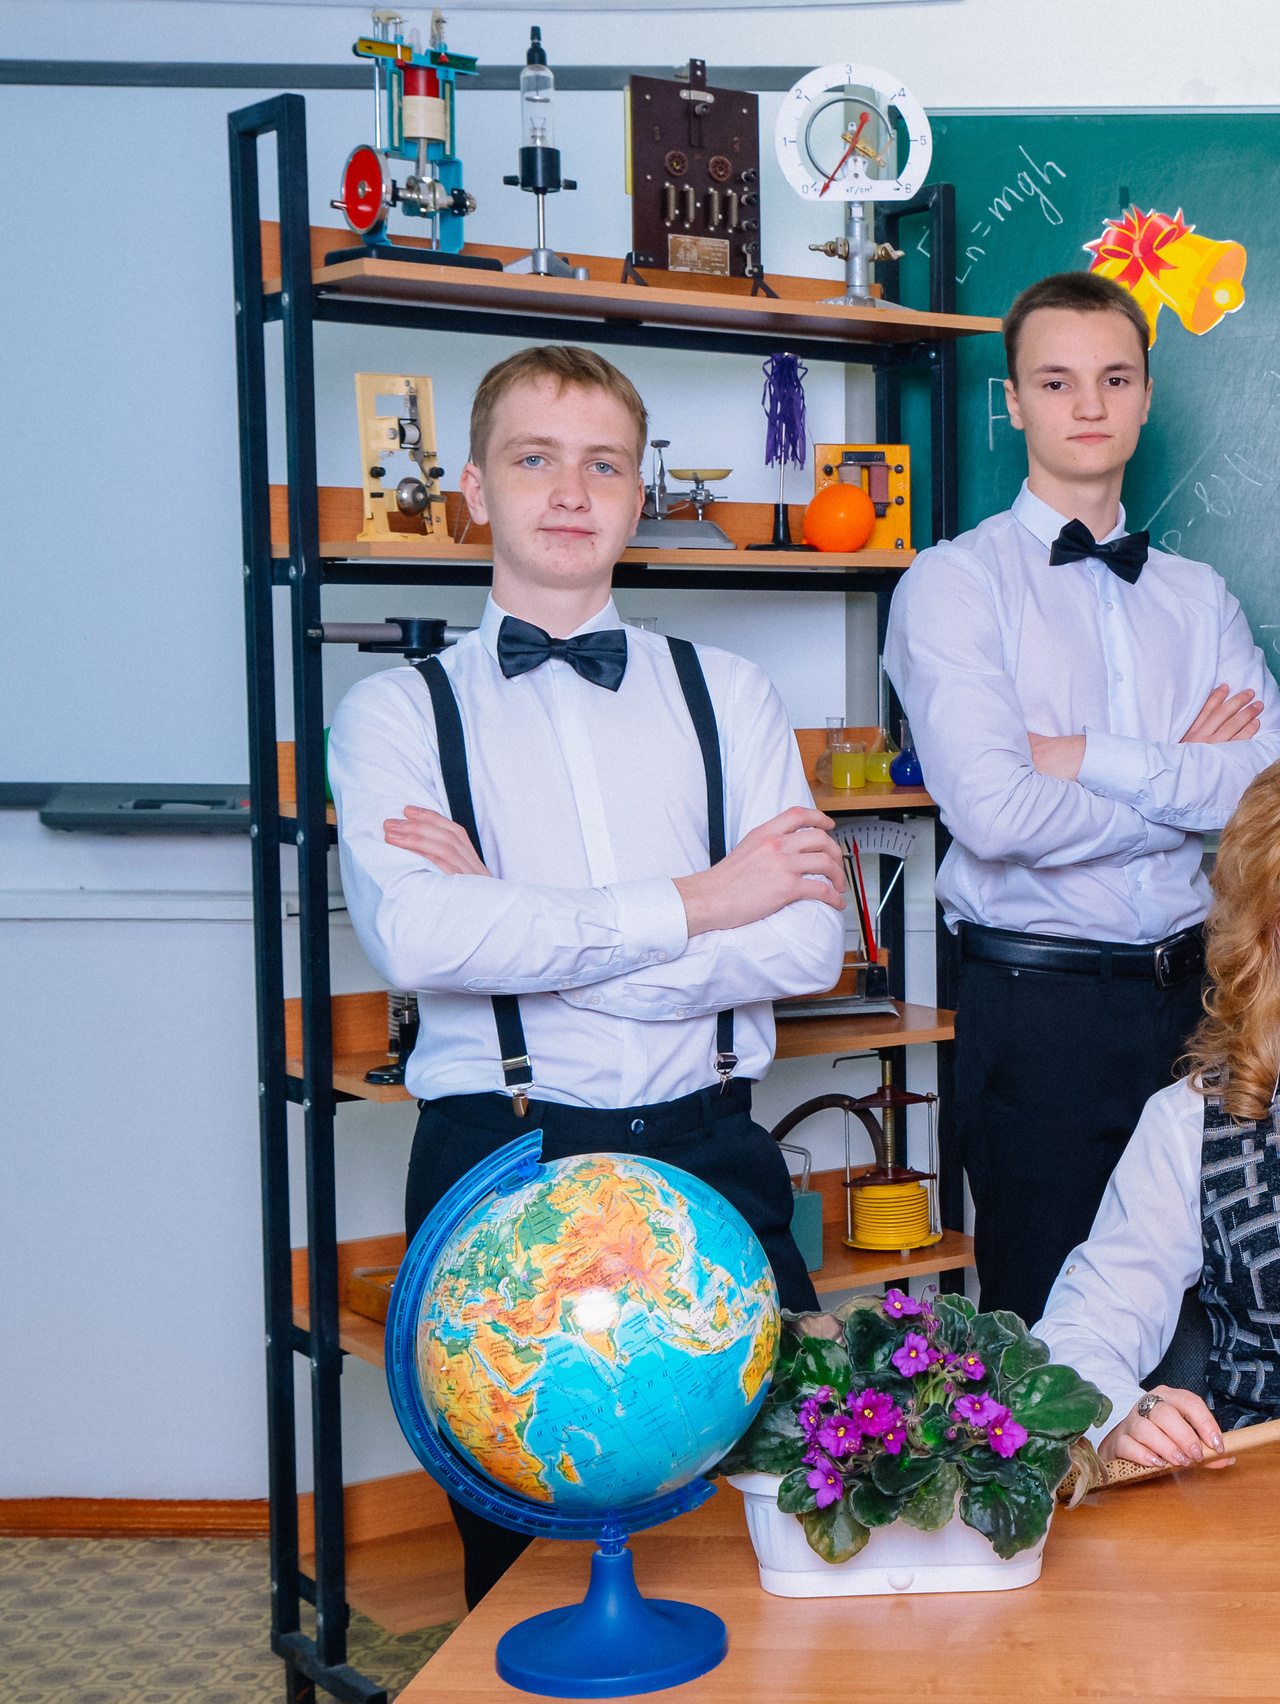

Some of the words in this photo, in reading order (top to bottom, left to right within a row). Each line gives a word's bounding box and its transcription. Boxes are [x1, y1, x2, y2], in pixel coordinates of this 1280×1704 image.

[845, 64, 852, 74] 3
[795, 89, 802, 100] 2
[898, 88, 906, 98] 4
[783, 137, 787, 146] 1
[920, 136, 926, 145] 5
[802, 185, 809, 194] 0
[905, 184, 912, 193] 6
